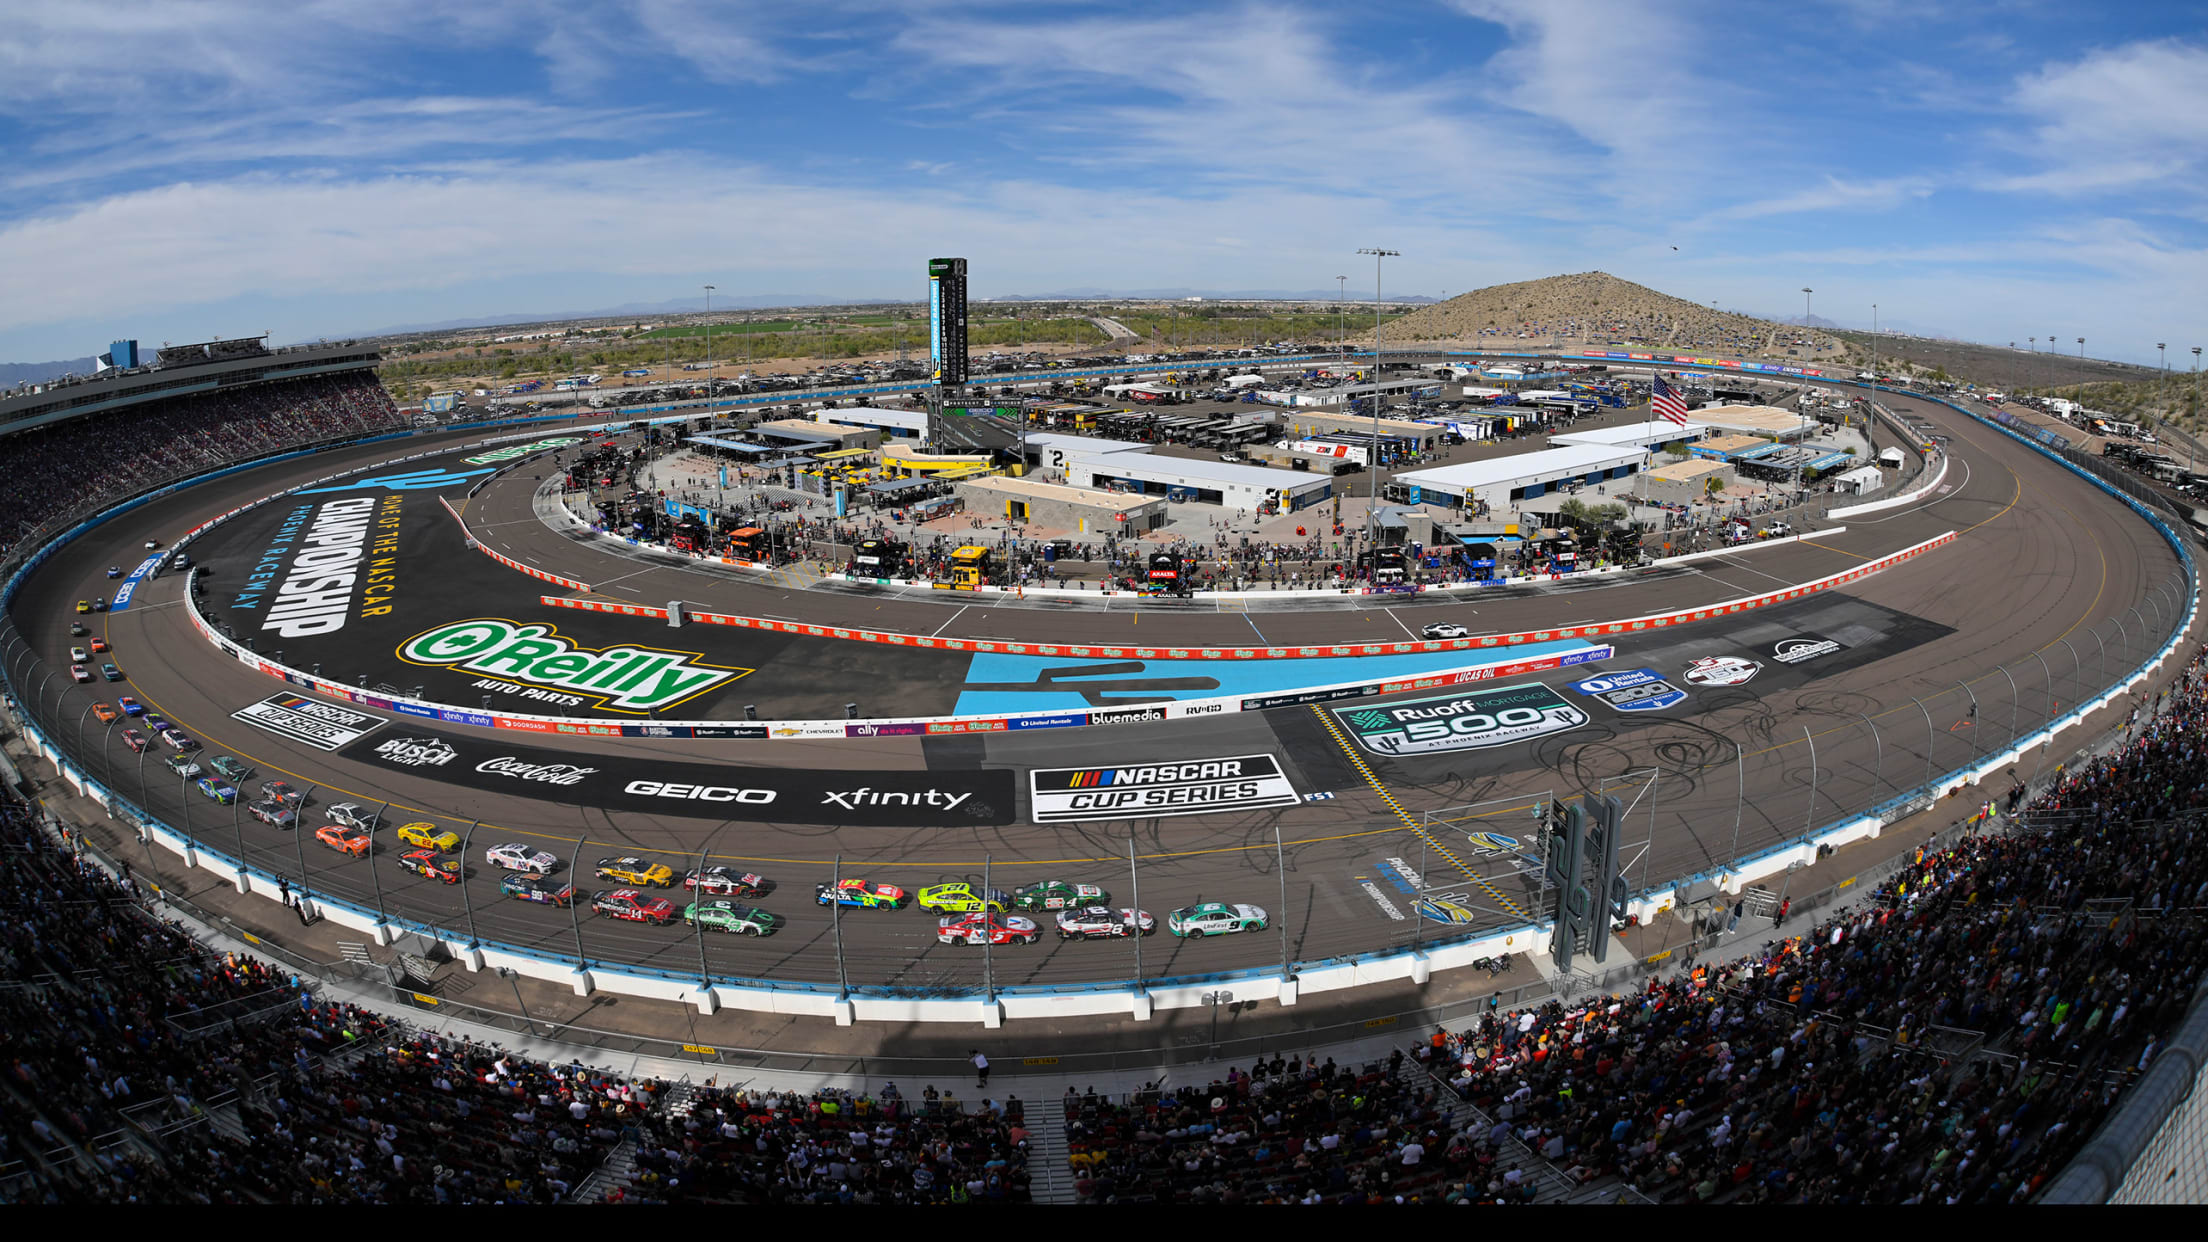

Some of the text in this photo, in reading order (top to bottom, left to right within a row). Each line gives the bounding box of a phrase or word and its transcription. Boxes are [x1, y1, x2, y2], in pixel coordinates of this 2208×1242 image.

[1052, 450, 1064, 466] 2
[272, 504, 314, 544] PHOENIX
[361, 495, 403, 618] HOME OF THE NASCAR
[261, 498, 376, 638] CHAMPIONSHIP
[231, 548, 288, 608] RACEWAY
[405, 620, 735, 709] O'Reilly
[1454, 670, 1482, 684] LUCAS
[1482, 668, 1496, 679] OIL
[1608, 672, 1645, 682] United
[1614, 676, 1655, 687] Rentals
[472, 678, 584, 707] AUTO PARTS
[1606, 684, 1669, 704] 200
[296, 703, 366, 726] NASCAR
[1092, 708, 1162, 724] bluemedia
[1391, 691, 1550, 722] Ruoff MORTGAGE
[256, 708, 344, 739] CUP SERIES
[444, 712, 464, 722] xfinity
[469, 716, 490, 726] xfinity
[512, 721, 546, 730] DOORDASH
[1407, 707, 1544, 741] 500
[857, 724, 879, 736] ally
[1446, 734, 1491, 745] PHOENIX
[1496, 726, 1542, 737] RACEWAY
[374, 740, 459, 766] BUSCH
[381, 753, 426, 767] LIGHT
[1113, 760, 1241, 786] NASCAR
[624, 780, 777, 804] GEICO
[821, 788, 972, 810] xfinity
[1070, 782, 1258, 810] CUP SERIES
[1302, 792, 1335, 802] FS1
[630, 909, 642, 919] 14
[965, 902, 982, 911] 12
[1111, 924, 1124, 935] 8
[1228, 920, 1241, 930] 9
[993, 932, 1004, 940] 5
